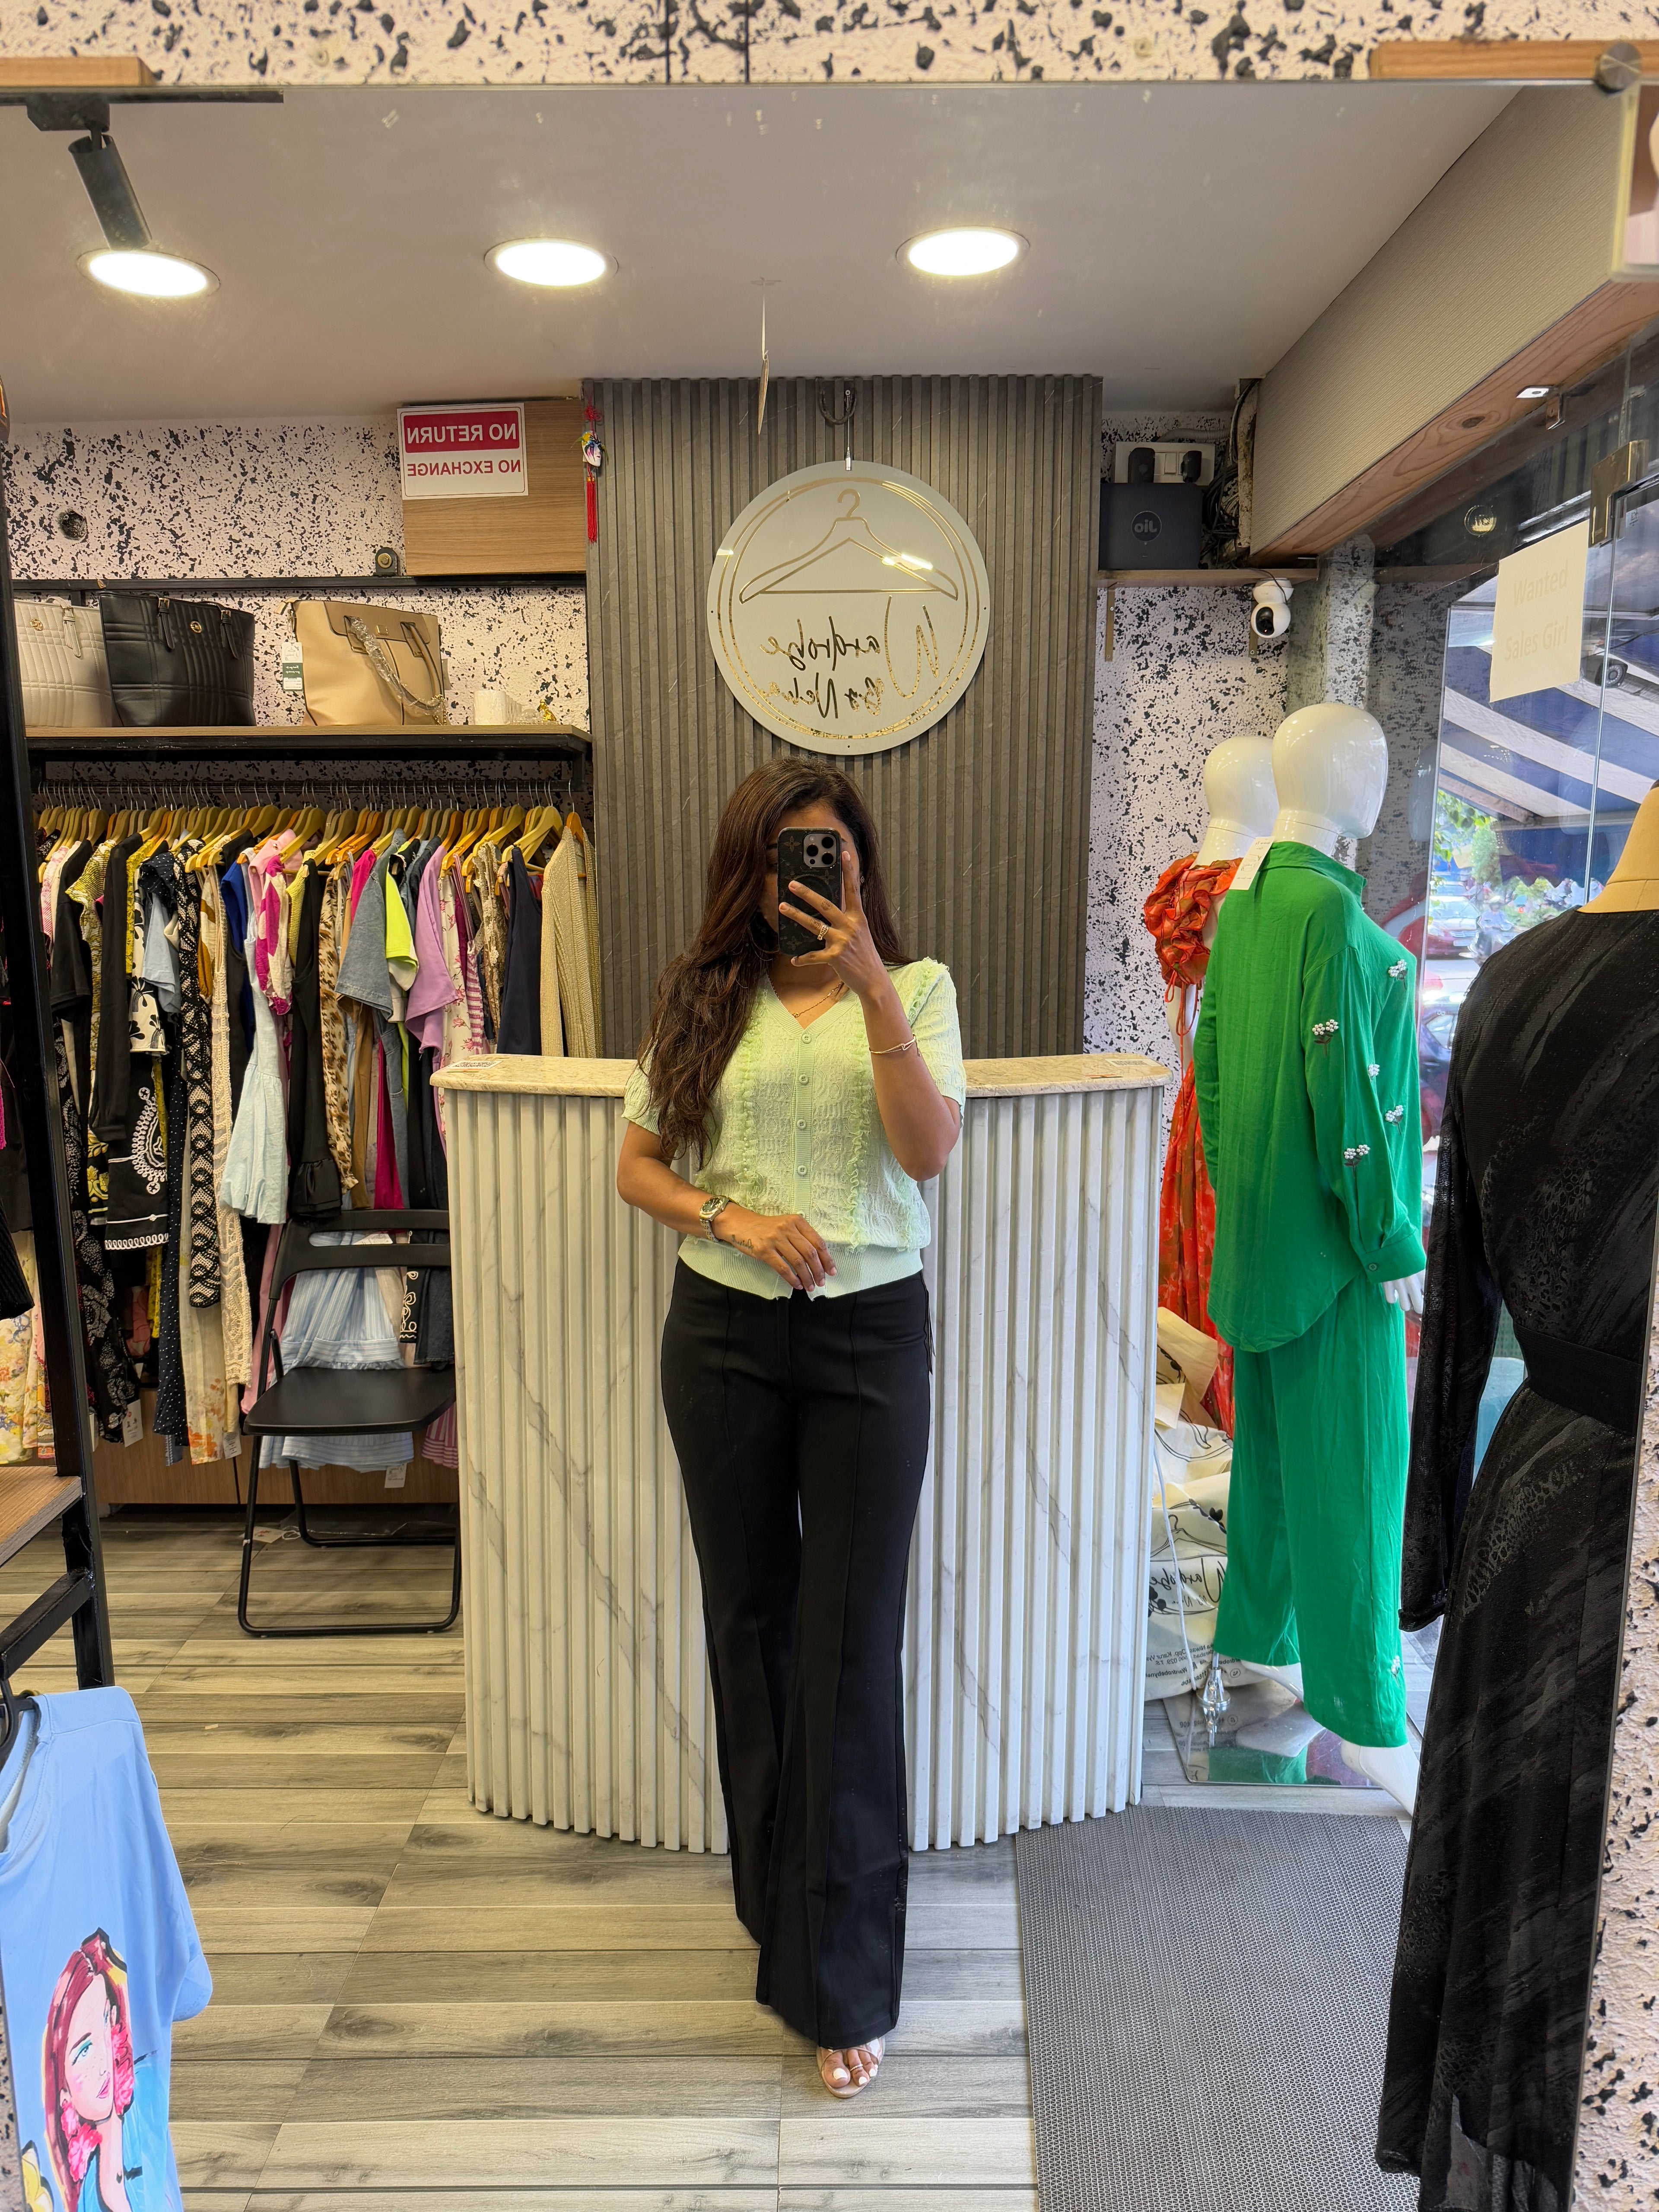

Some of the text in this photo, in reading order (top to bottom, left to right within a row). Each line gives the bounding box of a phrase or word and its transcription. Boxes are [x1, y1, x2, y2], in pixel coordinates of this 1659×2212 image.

[1513, 559, 1568, 606] Wanted
[1504, 616, 1569, 662] Sales Girl
